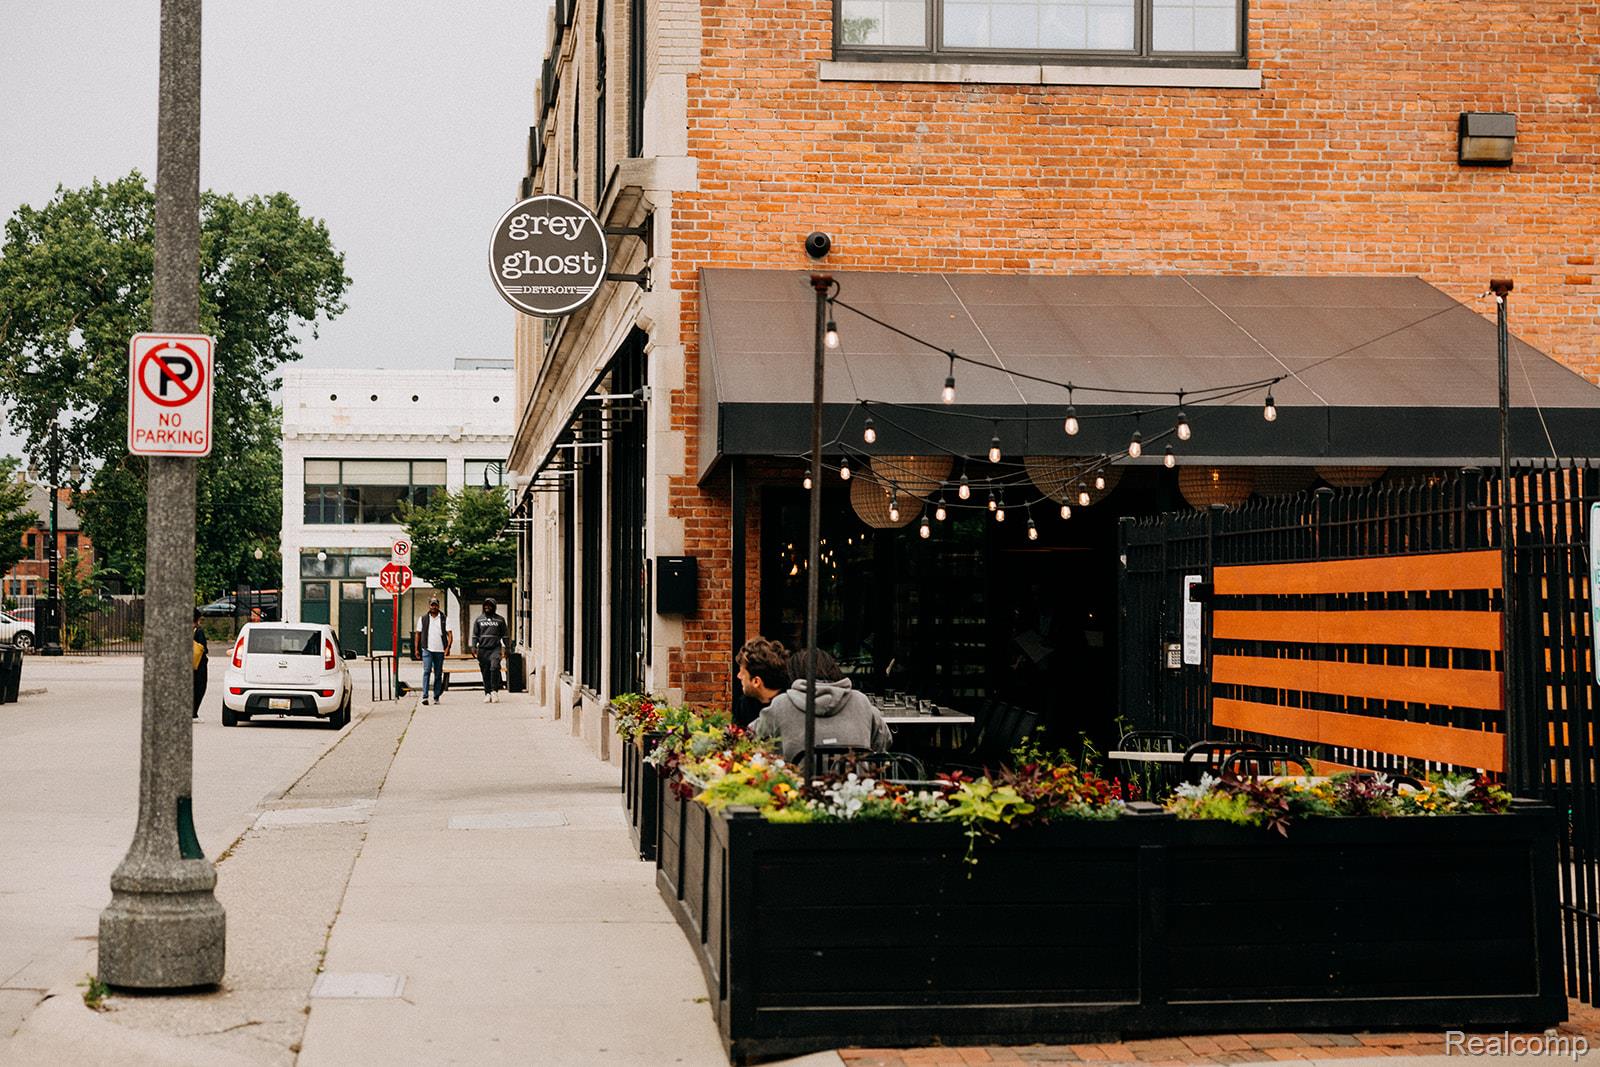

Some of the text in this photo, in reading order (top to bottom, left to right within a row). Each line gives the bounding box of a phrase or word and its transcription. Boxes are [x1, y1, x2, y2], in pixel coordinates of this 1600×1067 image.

[508, 213, 589, 241] grey
[501, 248, 597, 280] ghost
[523, 285, 577, 294] DETROIT
[159, 356, 193, 396] P
[159, 413, 181, 428] NO
[136, 429, 204, 445] PARKING
[381, 571, 410, 585] STOP
